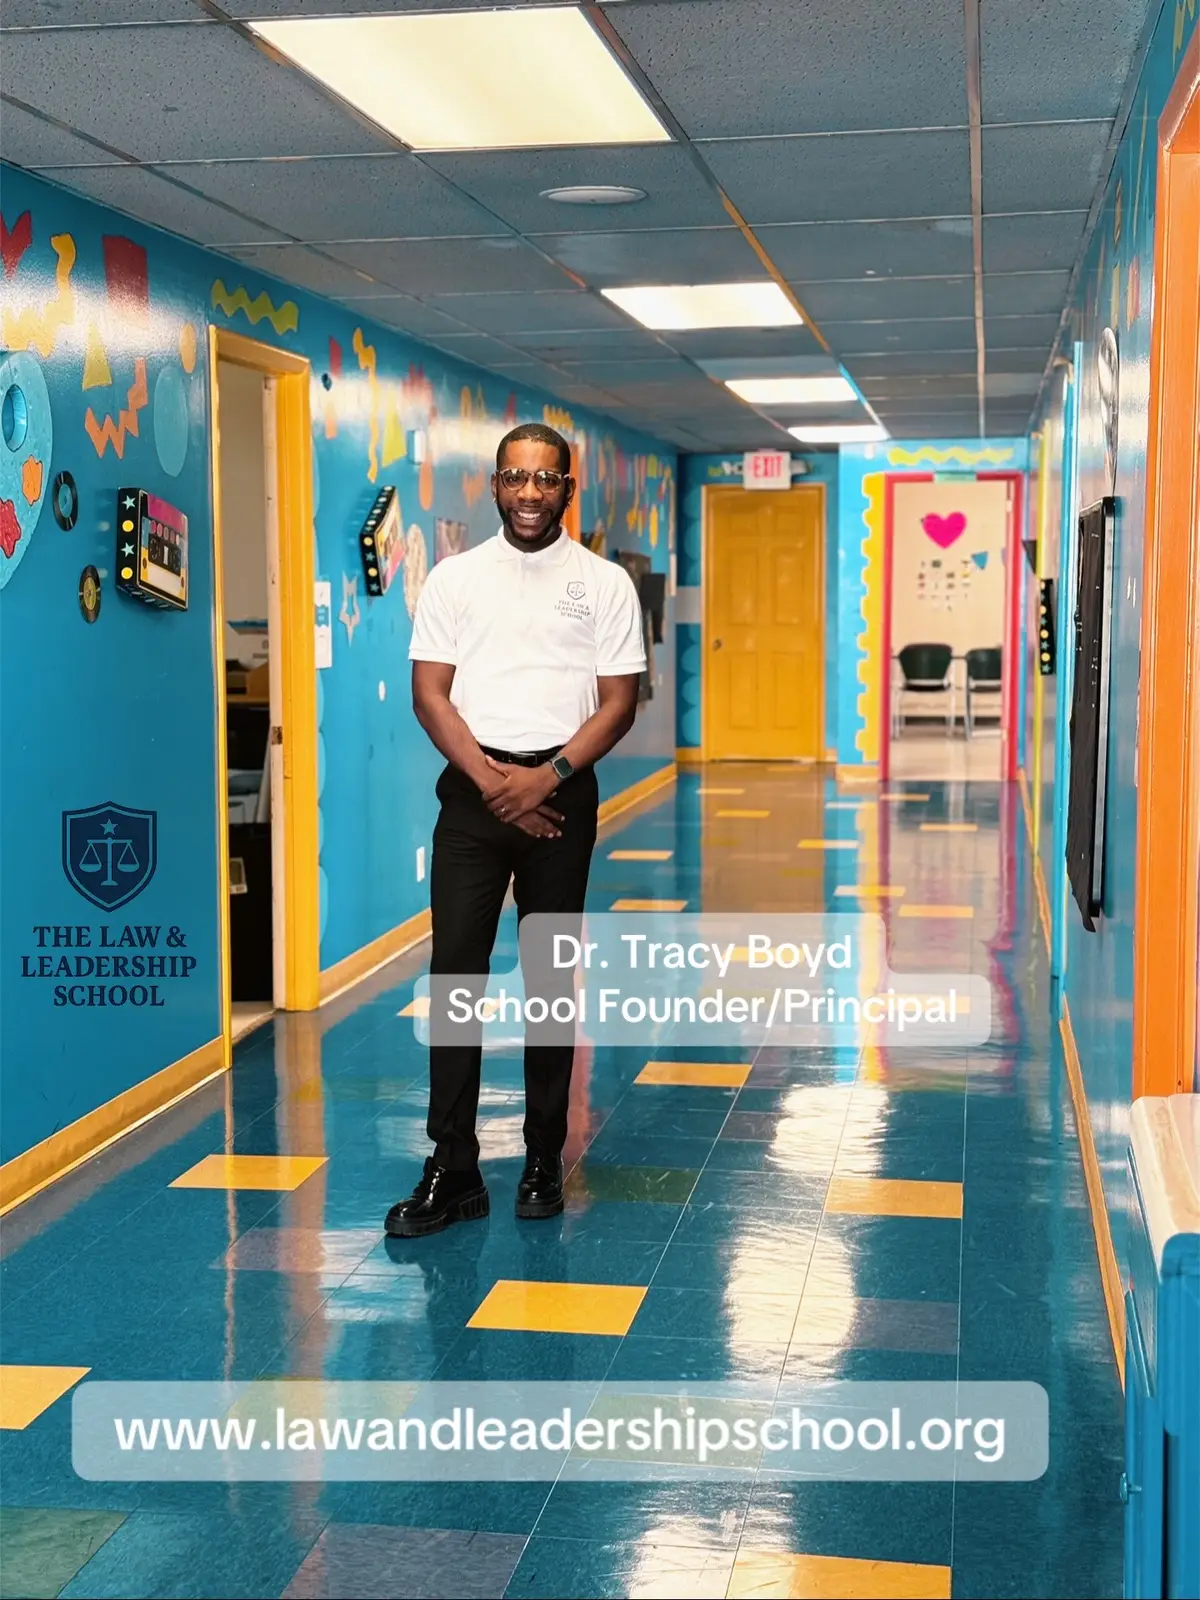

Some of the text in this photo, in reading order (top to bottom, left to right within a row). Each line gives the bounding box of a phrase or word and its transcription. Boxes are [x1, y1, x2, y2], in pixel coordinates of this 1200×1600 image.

[752, 455, 784, 478] EXIT
[33, 925, 187, 948] THE LAW &
[20, 955, 197, 978] LEADERSHIP
[53, 985, 165, 1007] SCHOOL
